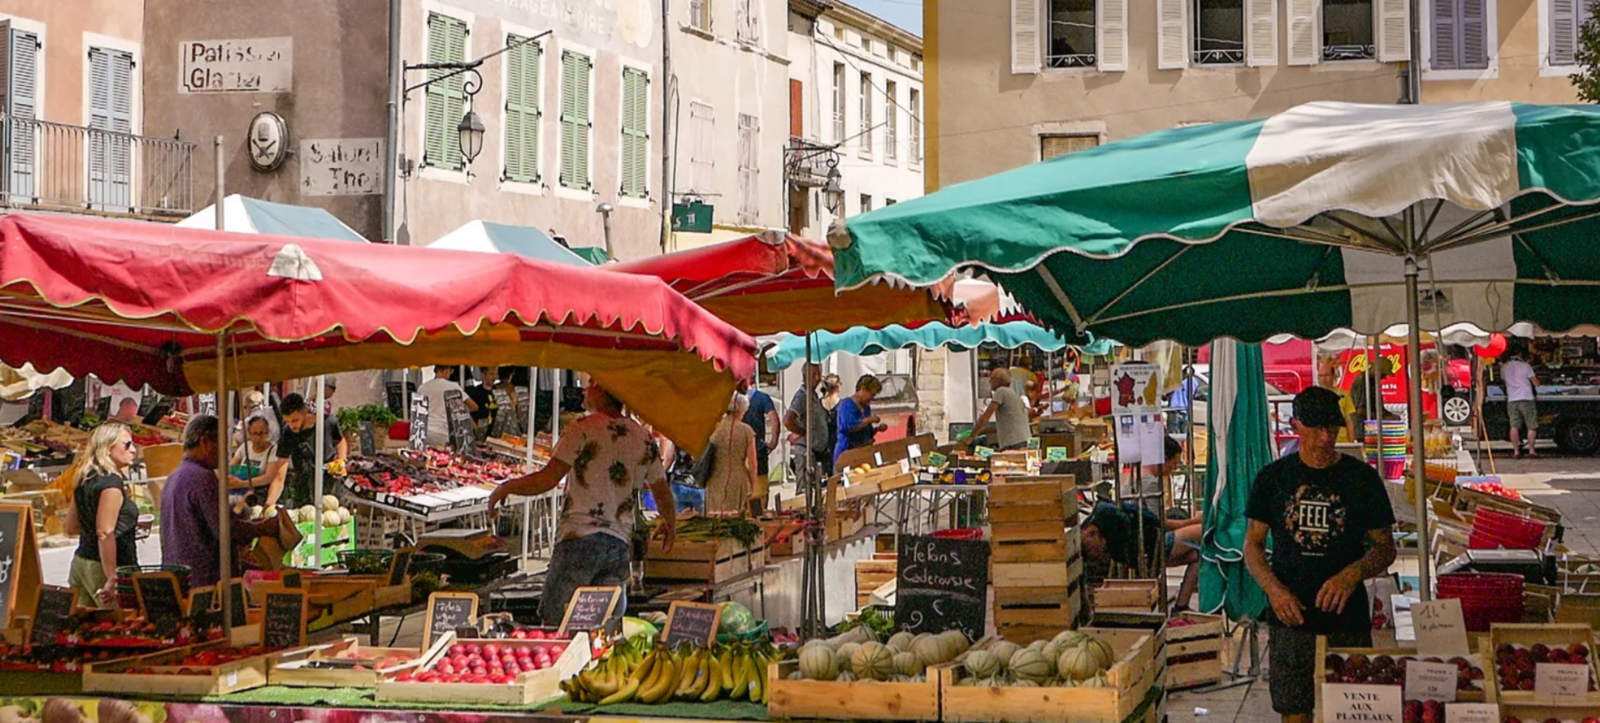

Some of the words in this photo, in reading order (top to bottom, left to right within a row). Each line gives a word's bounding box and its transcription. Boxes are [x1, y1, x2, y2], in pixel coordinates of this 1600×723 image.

[1299, 505, 1329, 528] FEEL
[905, 541, 961, 565] Melons
[1343, 691, 1380, 701] VENTE
[1350, 703, 1373, 711] AUX
[1336, 712, 1394, 722] PLATEAUX
